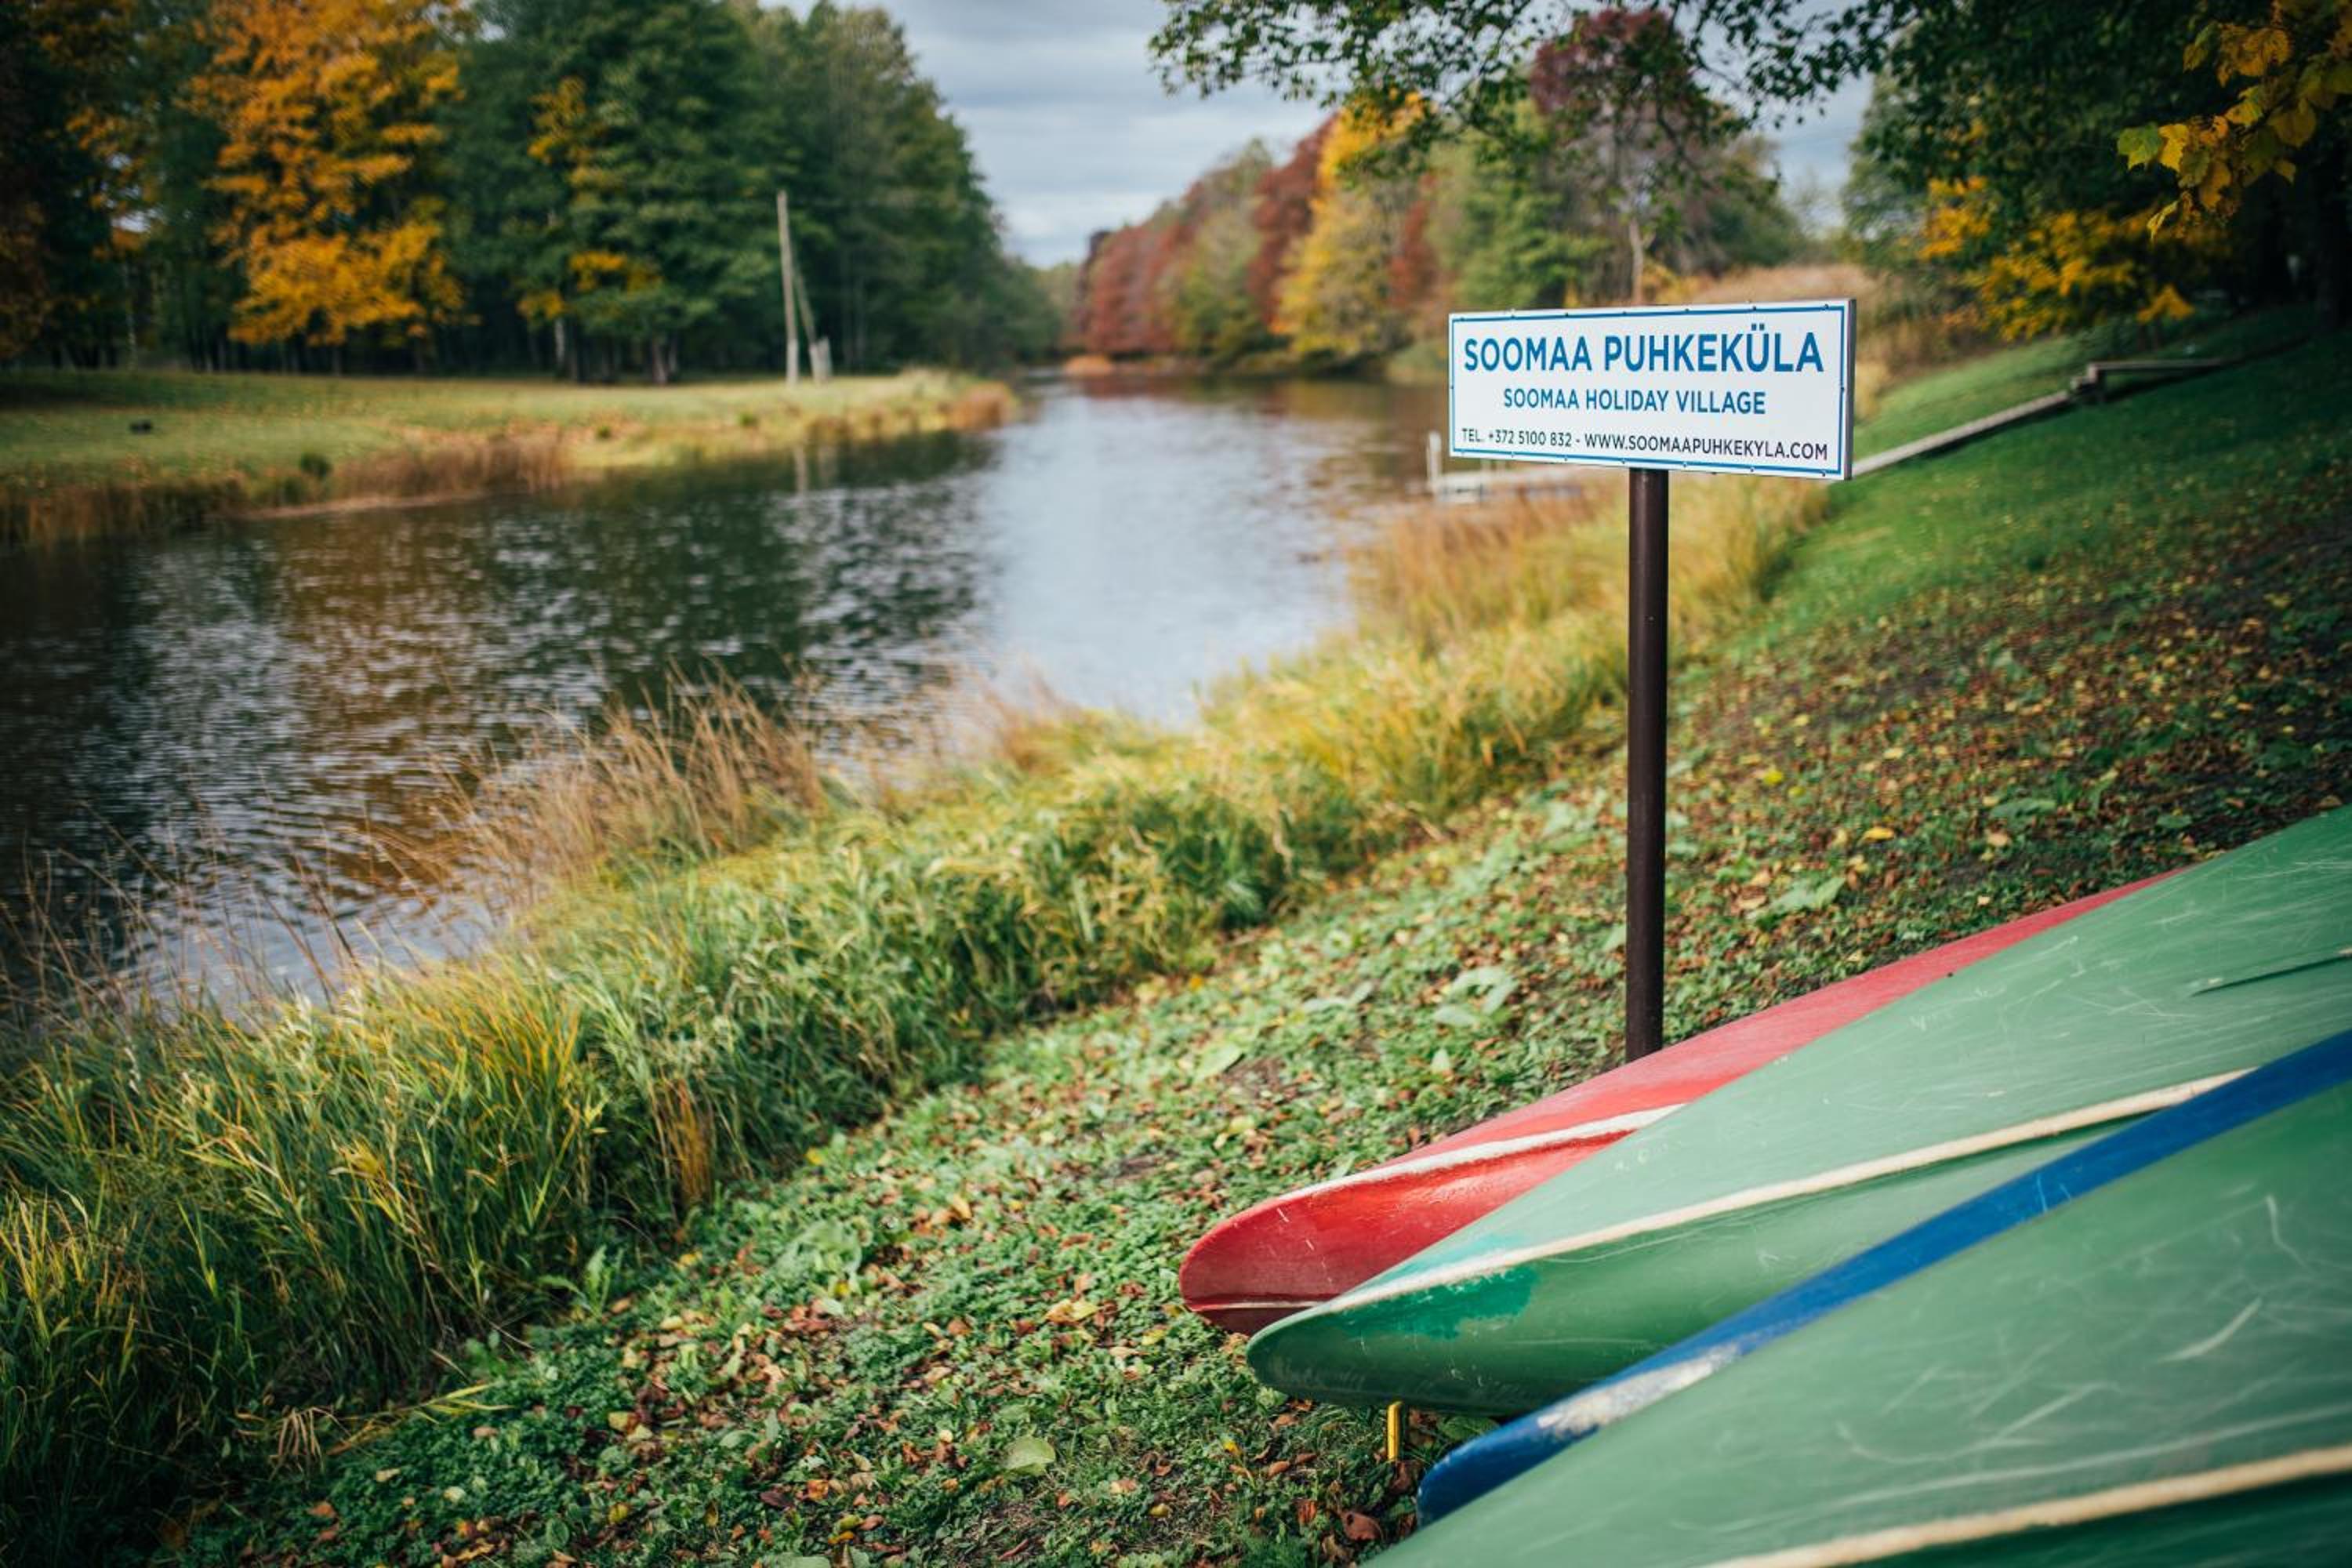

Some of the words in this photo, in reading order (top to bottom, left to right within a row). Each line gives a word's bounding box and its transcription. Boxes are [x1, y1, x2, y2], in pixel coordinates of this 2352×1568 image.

[1464, 337, 1592, 372] SOOMAA
[1604, 323, 1824, 372] PUHKEKÜLA
[1504, 388, 1579, 410] SOOMAA
[1585, 389, 1668, 412] HOLIDAY
[1675, 391, 1766, 415] VILLAGE
[1461, 428, 1484, 442] TEL.
[1488, 429, 1514, 445] +372
[1518, 430, 1546, 445] 5100
[1550, 432, 1572, 447] 832
[1584, 433, 1828, 460] WWW.SOOMAAPUHKEKYLA.COM
